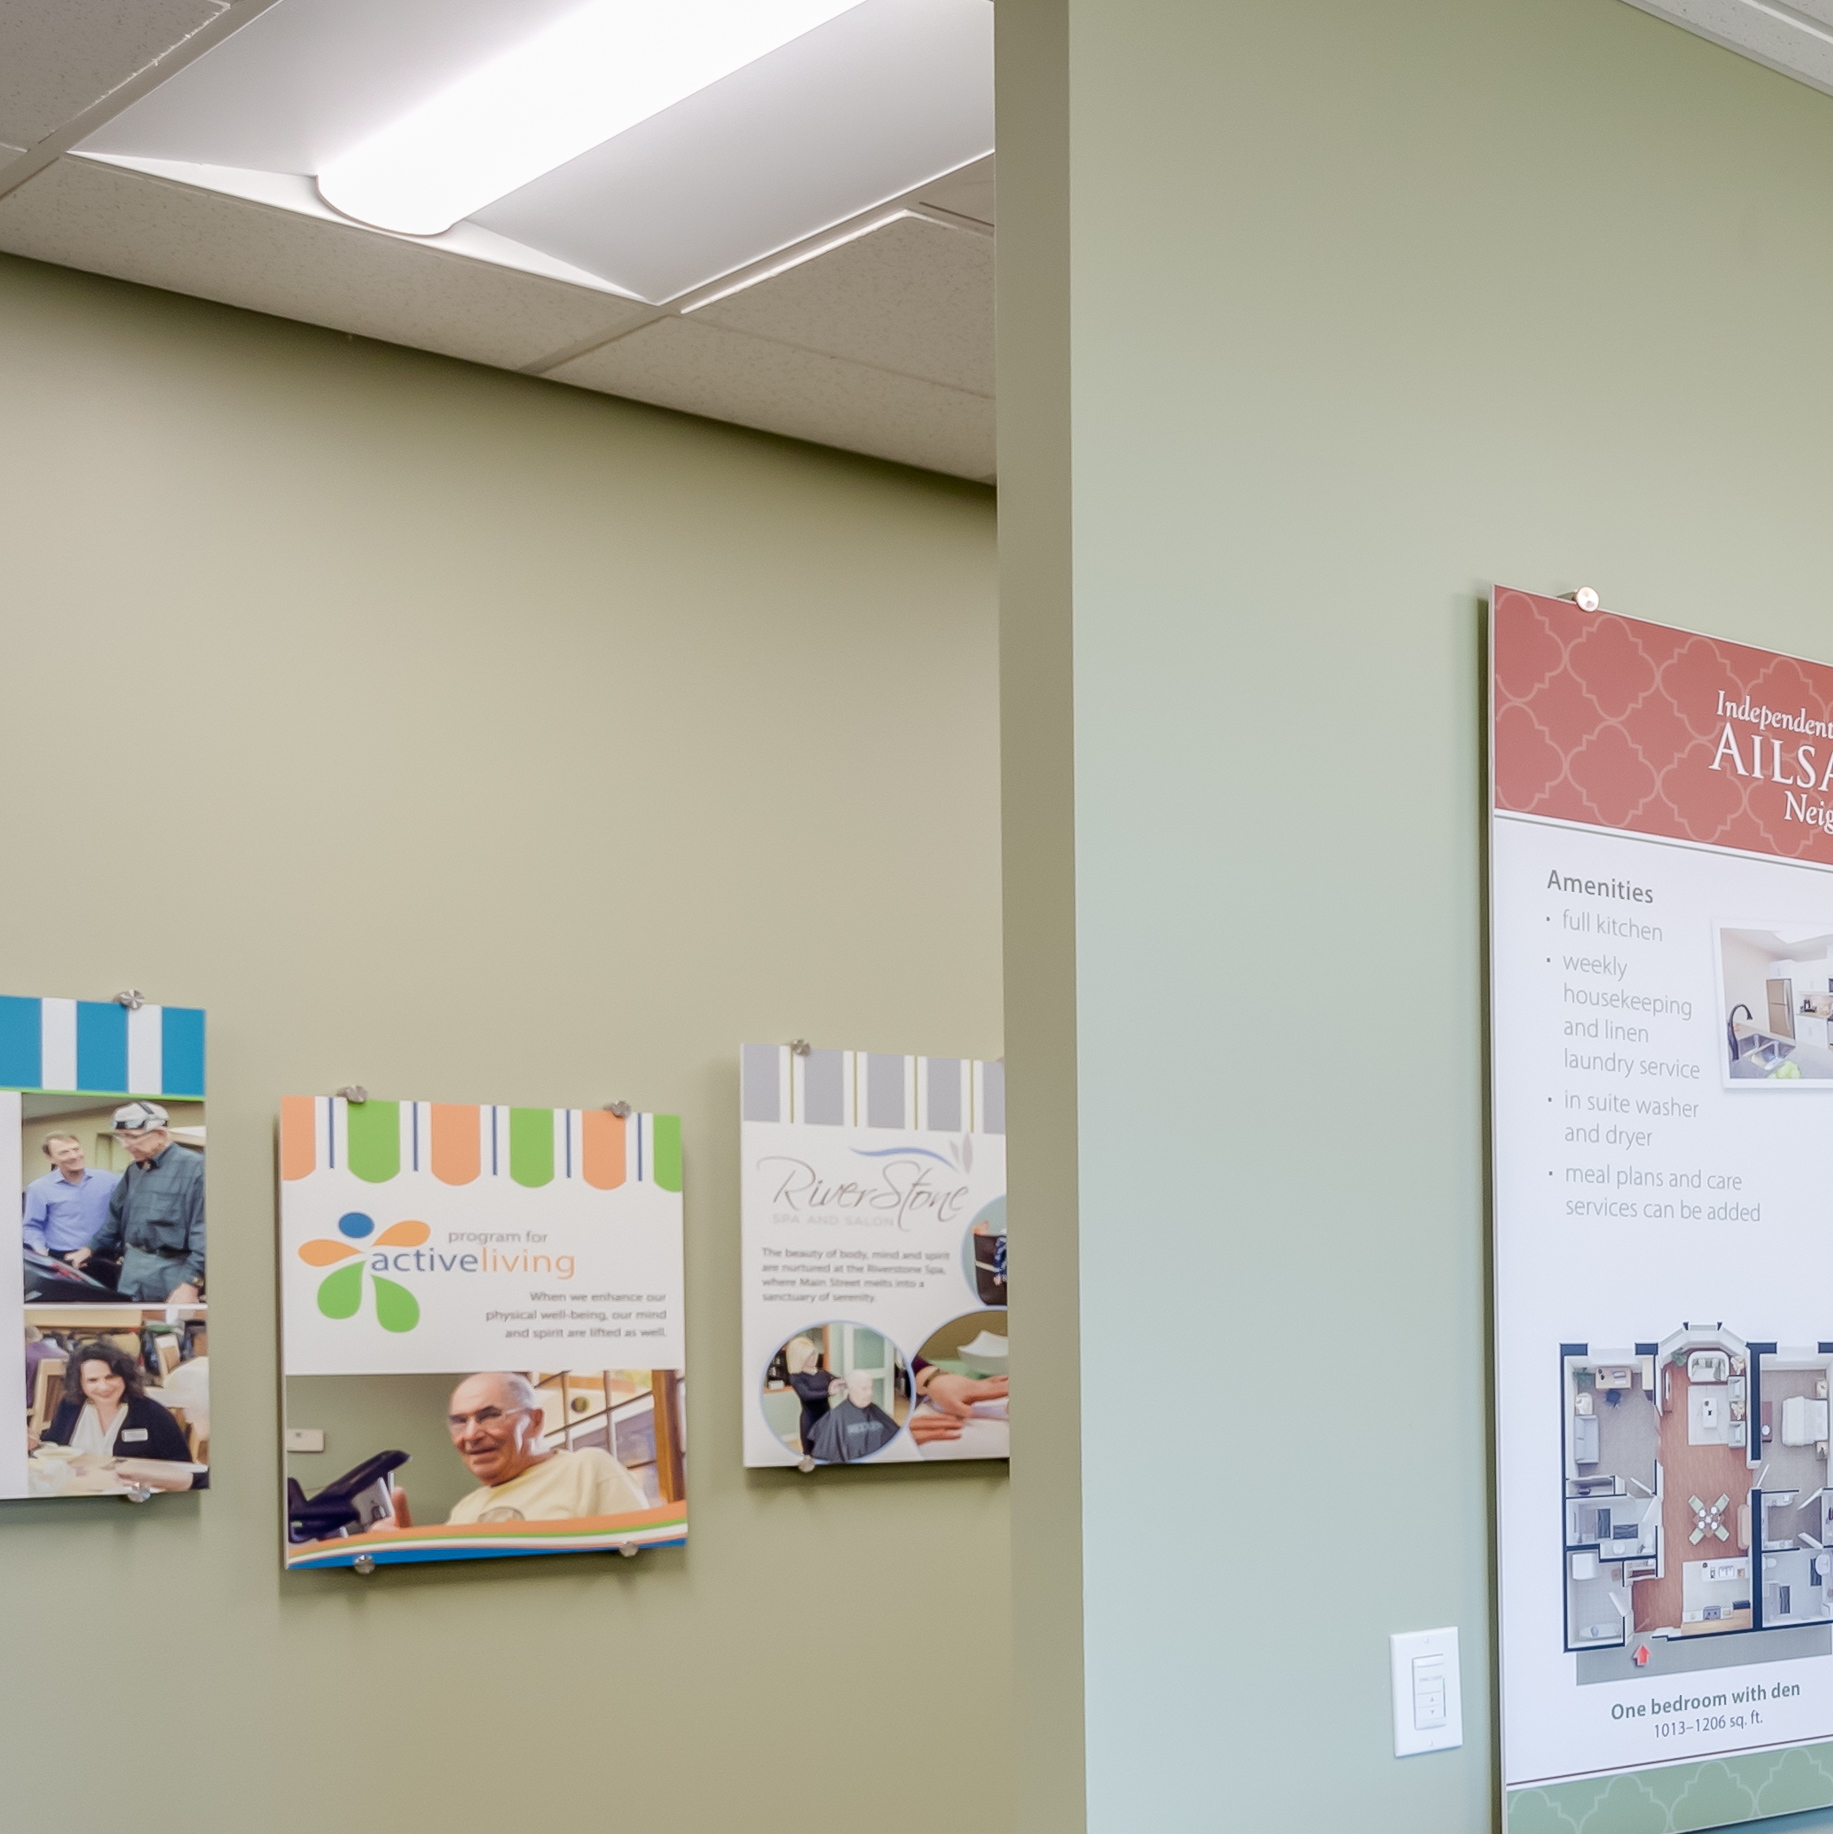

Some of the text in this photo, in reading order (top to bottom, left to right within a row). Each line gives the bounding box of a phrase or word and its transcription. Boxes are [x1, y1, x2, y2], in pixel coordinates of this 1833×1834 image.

[1547, 870, 1653, 903] Amenities
[1563, 909, 1663, 941] full kitchen
[1563, 955, 1628, 982] weekly
[1564, 982, 1692, 1021] housekeeping
[1564, 1019, 1649, 1043] and linen
[1564, 1048, 1700, 1079] laundry service
[1565, 1090, 1699, 1118] in suite washer
[1565, 1123, 1652, 1150] and dryer
[1566, 1164, 1742, 1191] meal plans and care
[772, 1213, 895, 1226] SPA AND SALON
[1566, 1198, 1761, 1222] services can be added
[448, 1230, 548, 1244] program for
[1611, 1683, 1800, 1720] One bedroom with den
[1654, 1710, 1763, 1738] 1013–1206 sq. ft.
